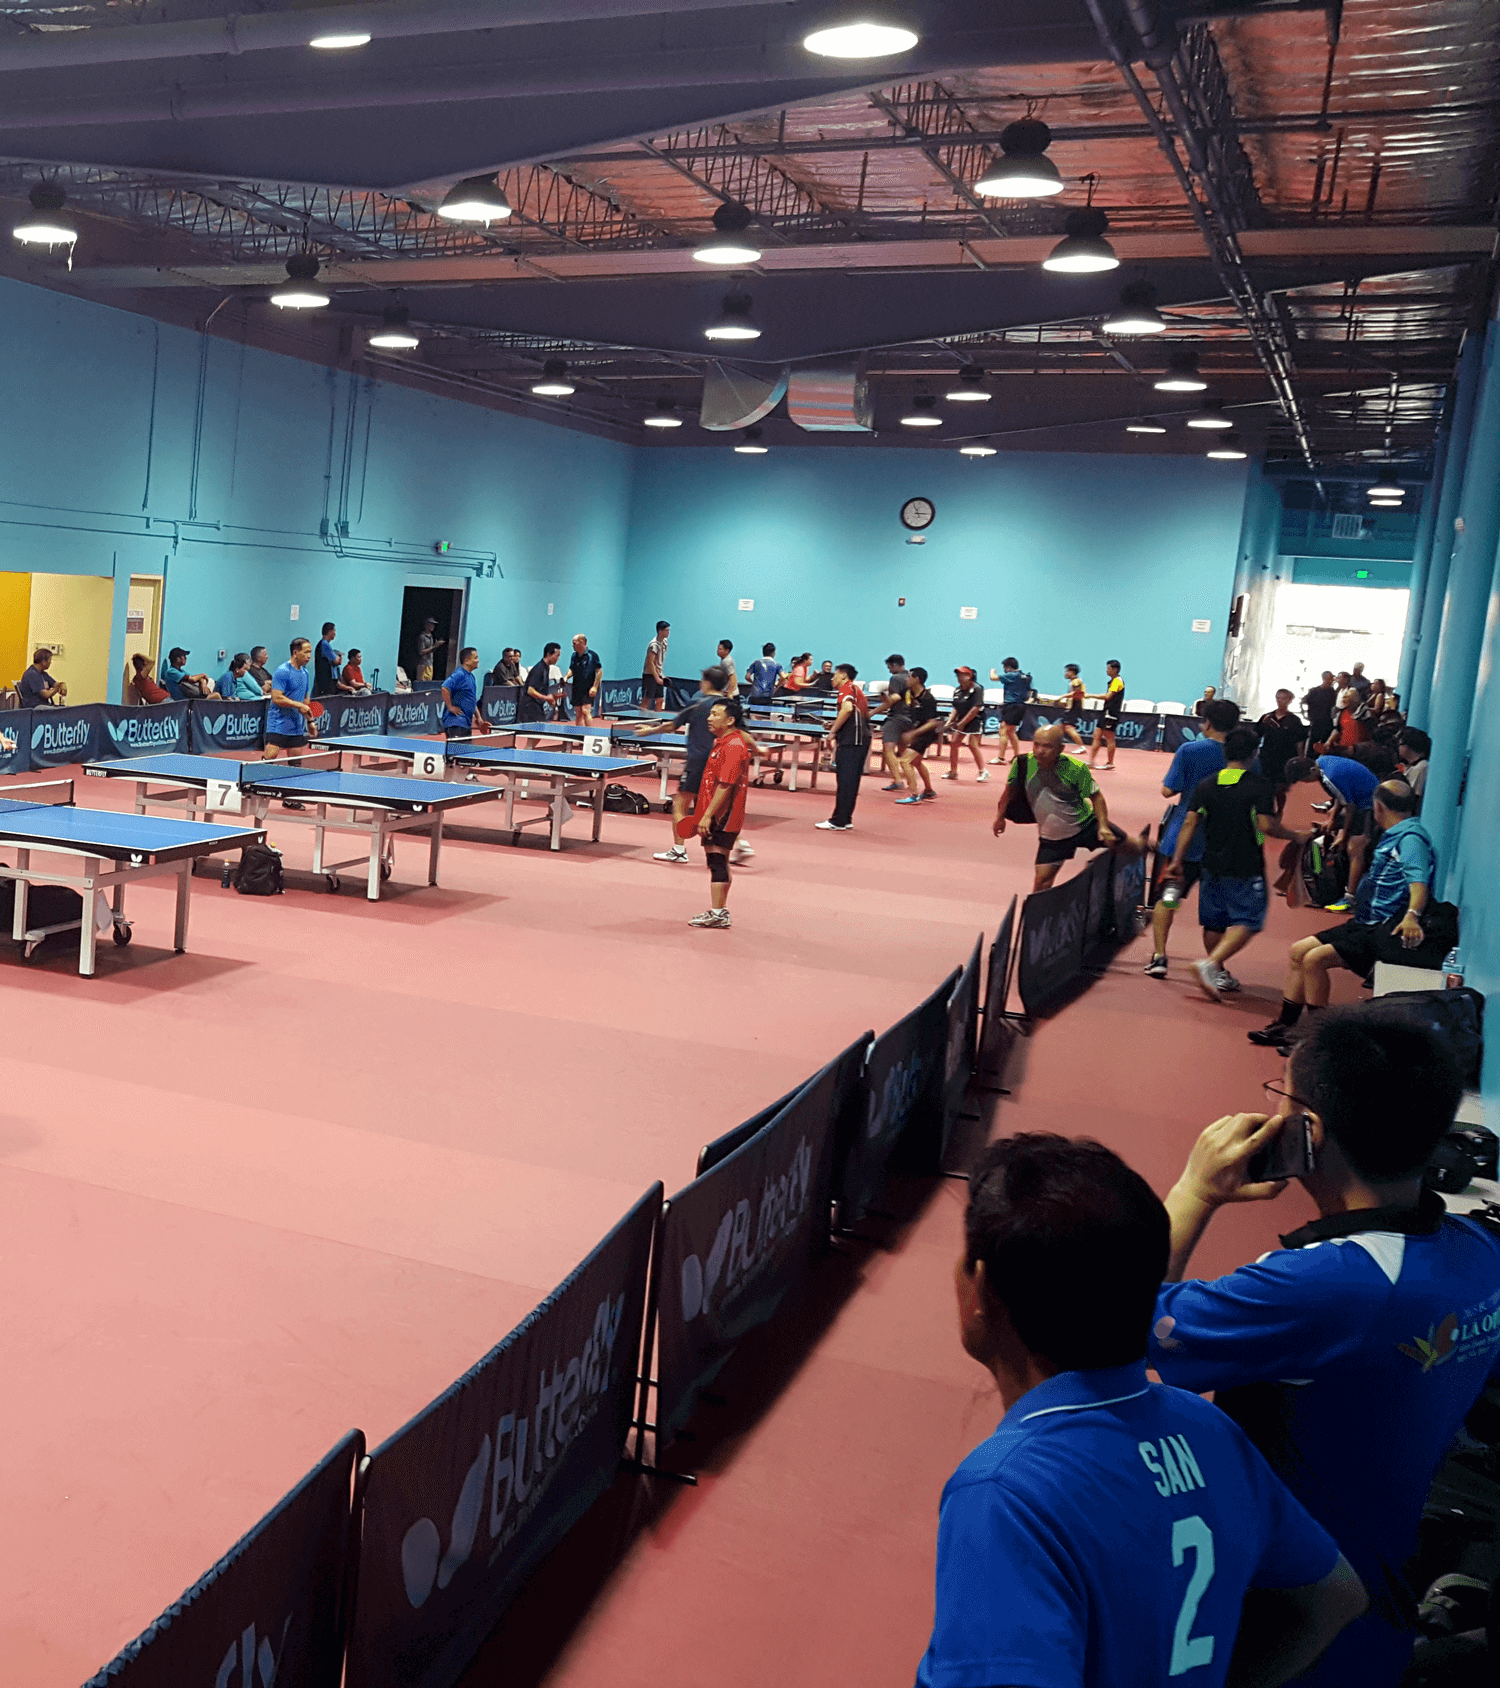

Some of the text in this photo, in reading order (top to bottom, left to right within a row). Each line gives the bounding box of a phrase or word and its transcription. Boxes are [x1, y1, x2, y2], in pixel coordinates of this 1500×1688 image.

[128, 715, 180, 743] Butterfly
[348, 705, 382, 728] Butterfly
[43, 719, 91, 749] Butterfly
[591, 738, 603, 754] 5
[423, 756, 436, 775] 6
[218, 783, 232, 806] 7
[1138, 1433, 1207, 1498] SAN
[1168, 1514, 1216, 1677] 2
